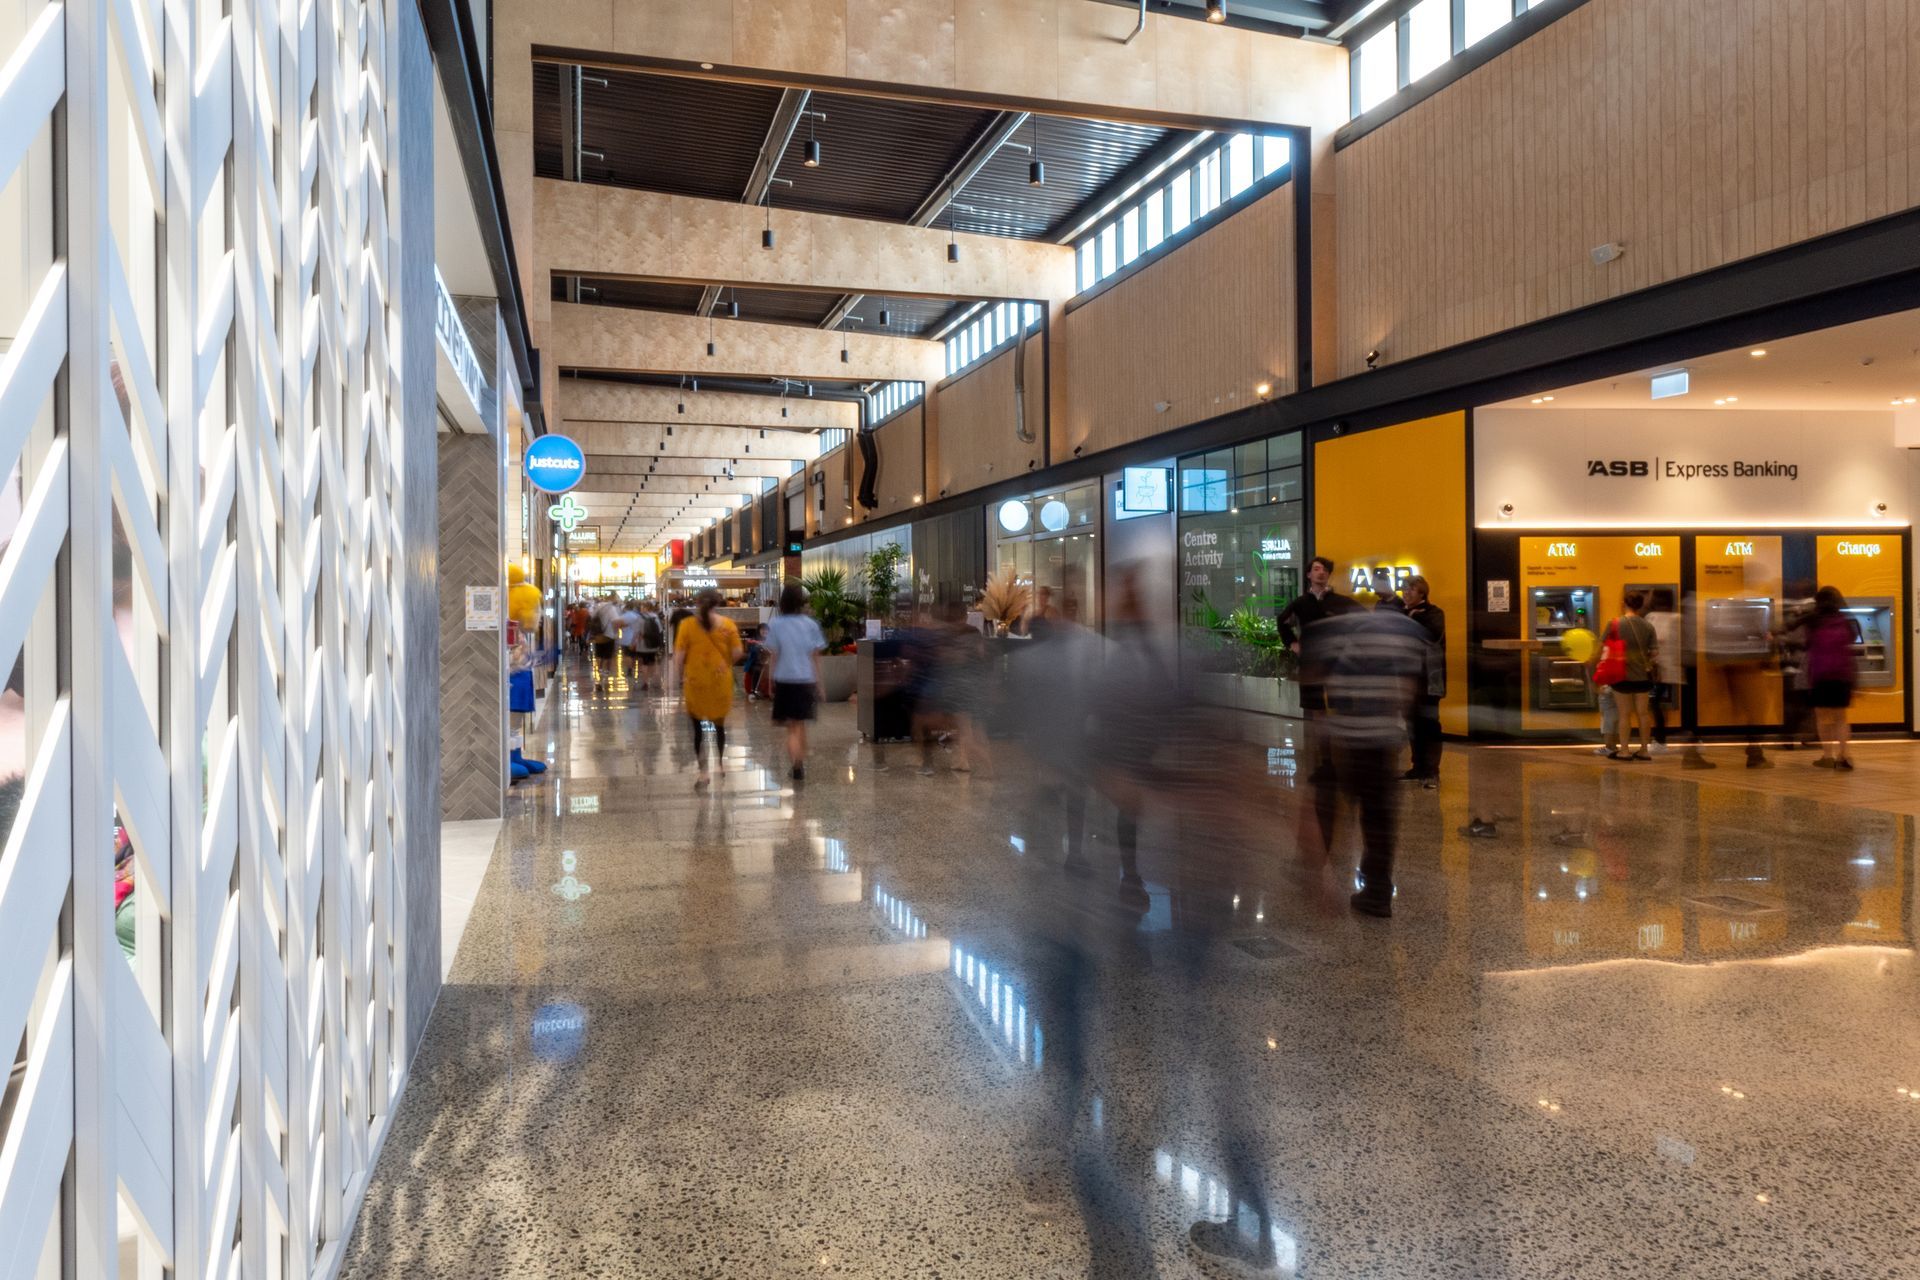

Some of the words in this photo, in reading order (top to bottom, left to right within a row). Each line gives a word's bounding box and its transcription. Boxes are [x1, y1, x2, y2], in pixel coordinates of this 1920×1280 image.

[529, 455, 580, 469] justcuts
[1587, 460, 1649, 477] ASB
[1665, 461, 1729, 480] Express
[1733, 461, 1798, 480] Banking
[1184, 531, 1218, 547] Centre
[1547, 543, 1576, 557] ATM
[1634, 542, 1662, 557] Coin
[1725, 541, 1753, 556] ATM
[1837, 541, 1881, 557] Change
[1184, 549, 1224, 569] Activity
[1184, 571, 1211, 586] Zone.
